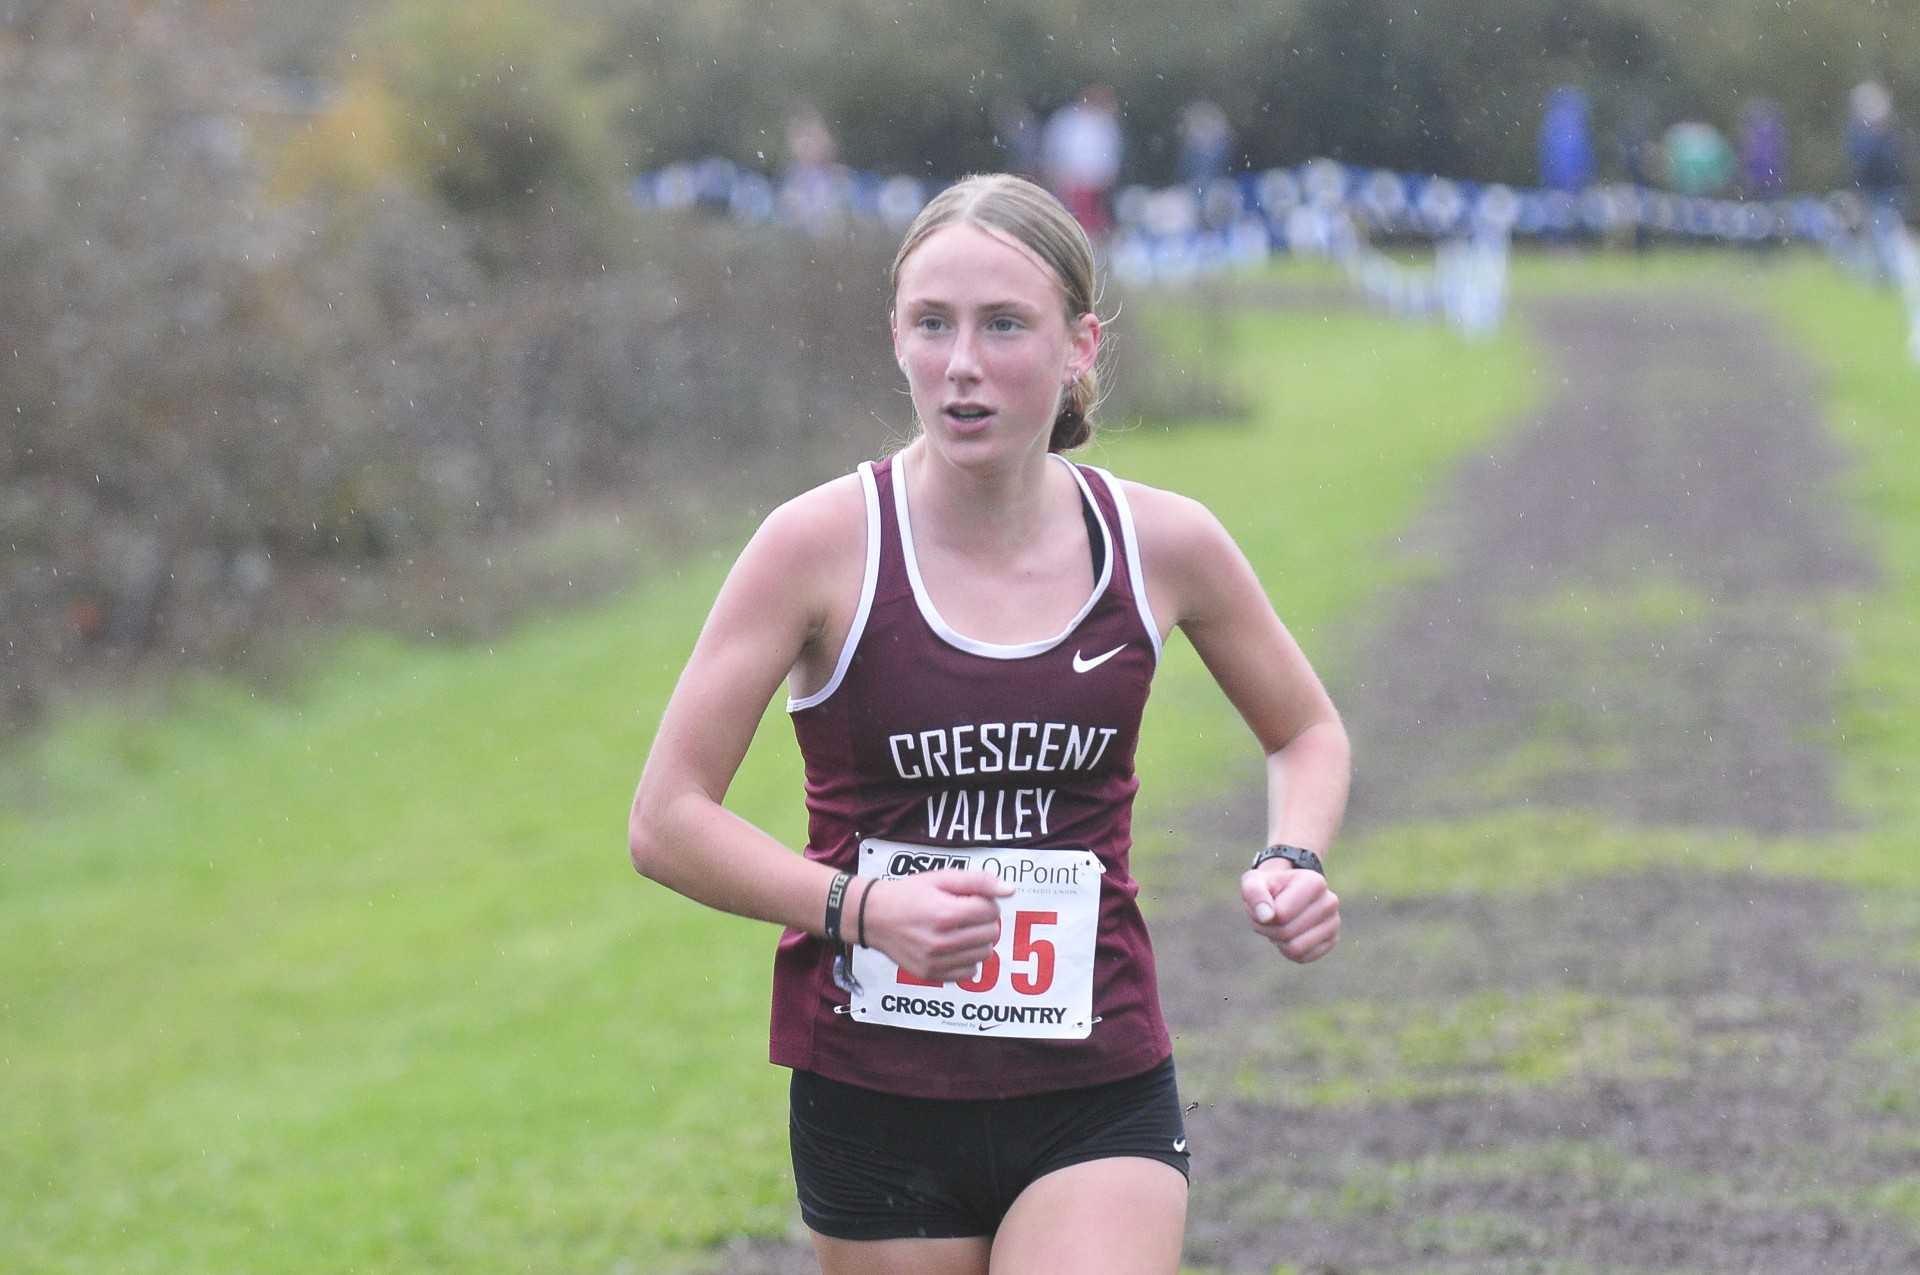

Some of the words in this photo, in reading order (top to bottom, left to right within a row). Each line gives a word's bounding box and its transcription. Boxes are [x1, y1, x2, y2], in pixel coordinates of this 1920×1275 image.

[889, 722, 1117, 779] CRESCENT
[927, 788, 1056, 841] VALLEY
[982, 857, 1079, 885] OnPoint
[881, 994, 955, 1019] CROSS
[962, 1003, 1067, 1024] COUNTRY
